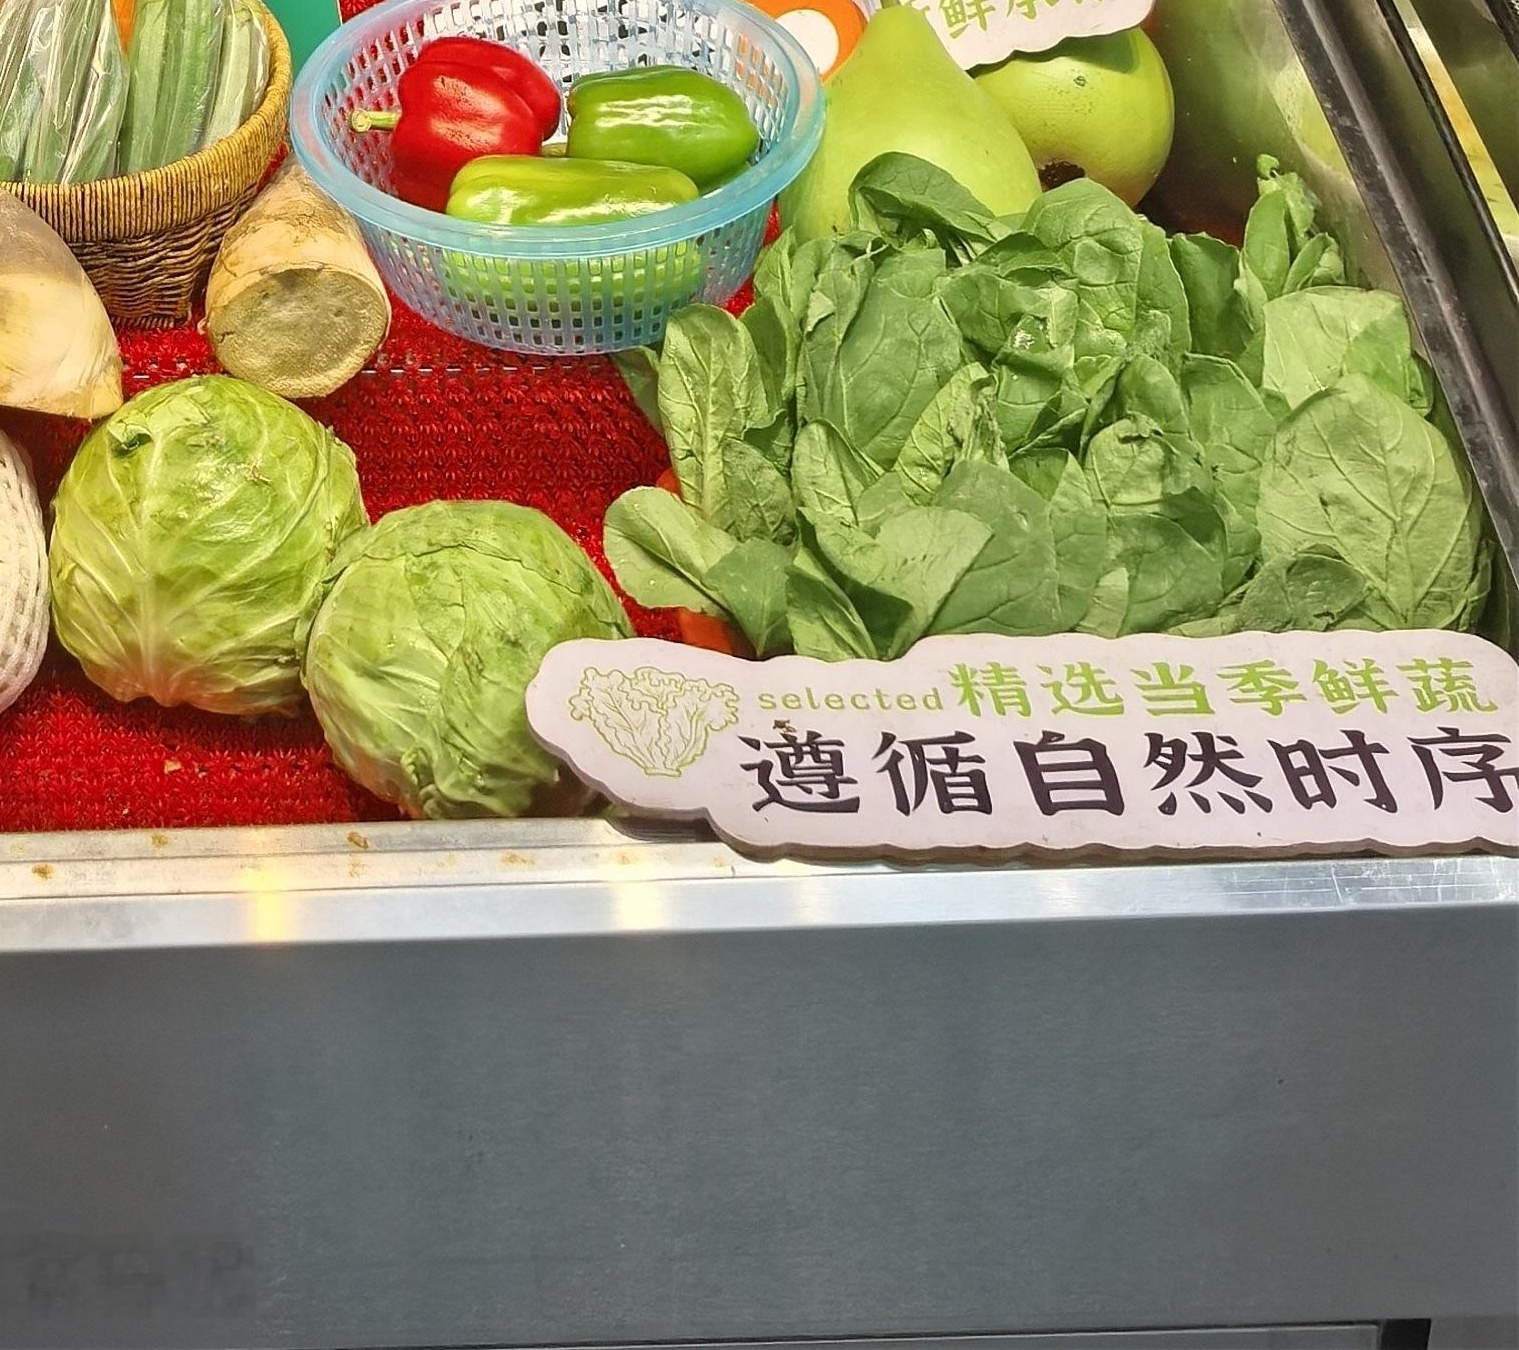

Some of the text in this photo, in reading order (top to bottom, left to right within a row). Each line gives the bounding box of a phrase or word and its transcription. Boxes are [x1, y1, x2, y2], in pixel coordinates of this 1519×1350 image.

[757, 658, 1497, 719] selected 精选当季鲜蔬
[739, 725, 1519, 817] 遵循自然时序
